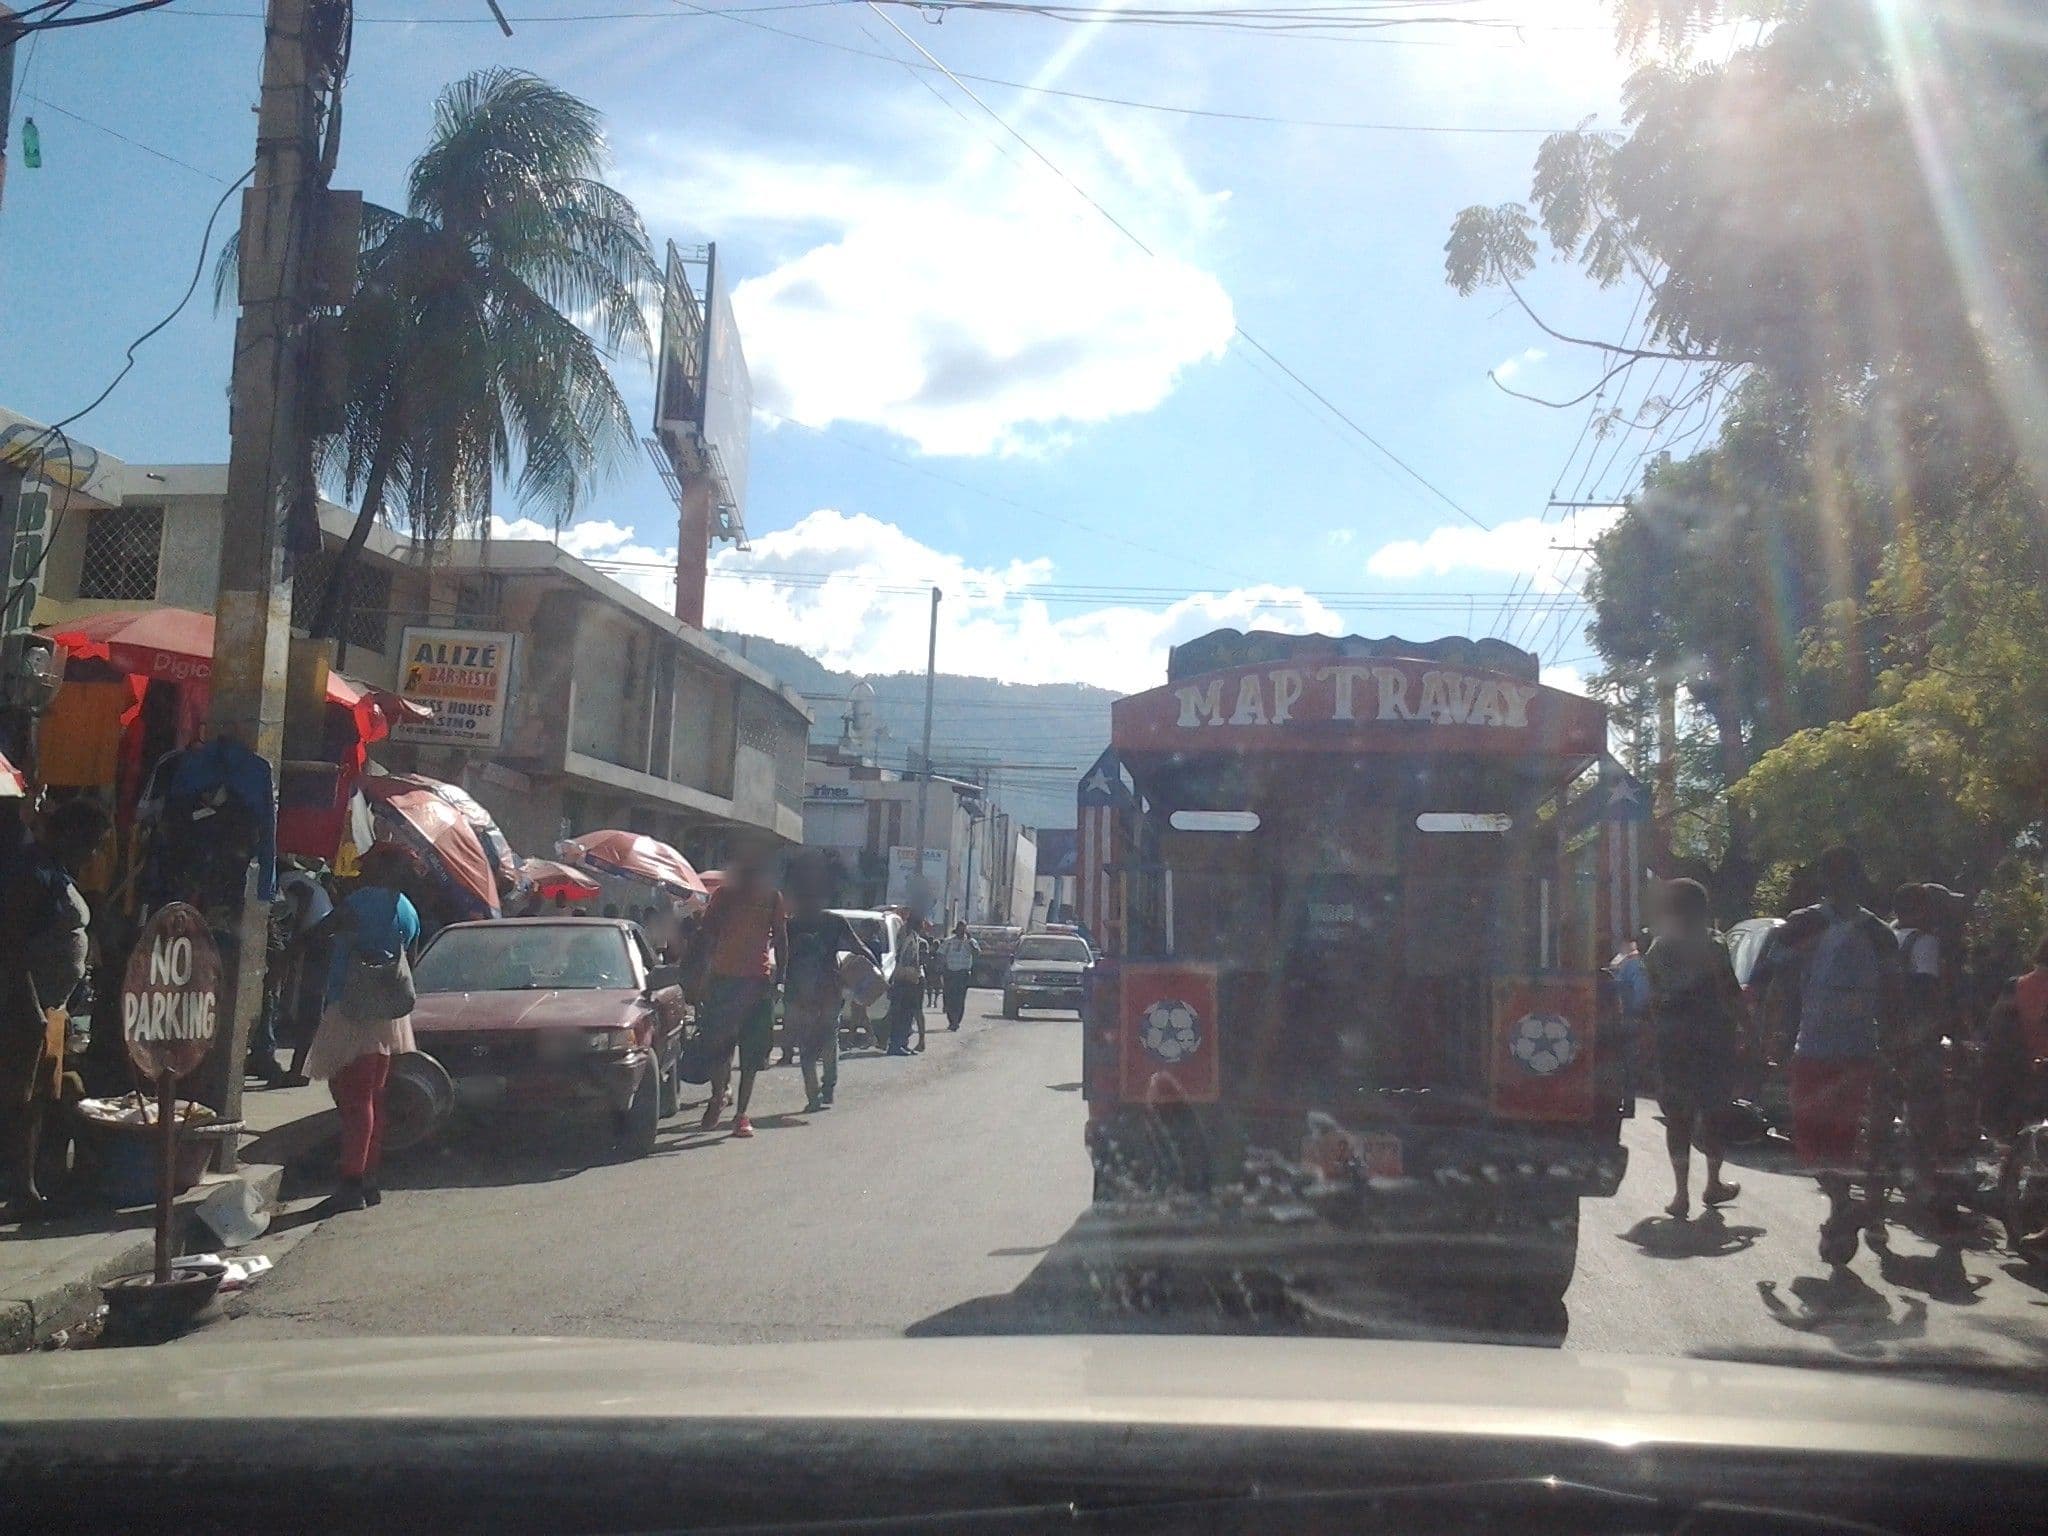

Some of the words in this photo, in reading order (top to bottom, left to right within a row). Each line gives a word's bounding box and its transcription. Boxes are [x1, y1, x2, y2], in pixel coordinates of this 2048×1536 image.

[153, 652, 211, 680] Digic
[414, 643, 496, 668] ALIZÉ
[446, 701, 493, 717] HOUSE
[1175, 669, 1302, 727] MAP
[1316, 665, 1537, 728] TRAVAY
[150, 934, 193, 986] NO
[124, 991, 216, 1042] PARKING
